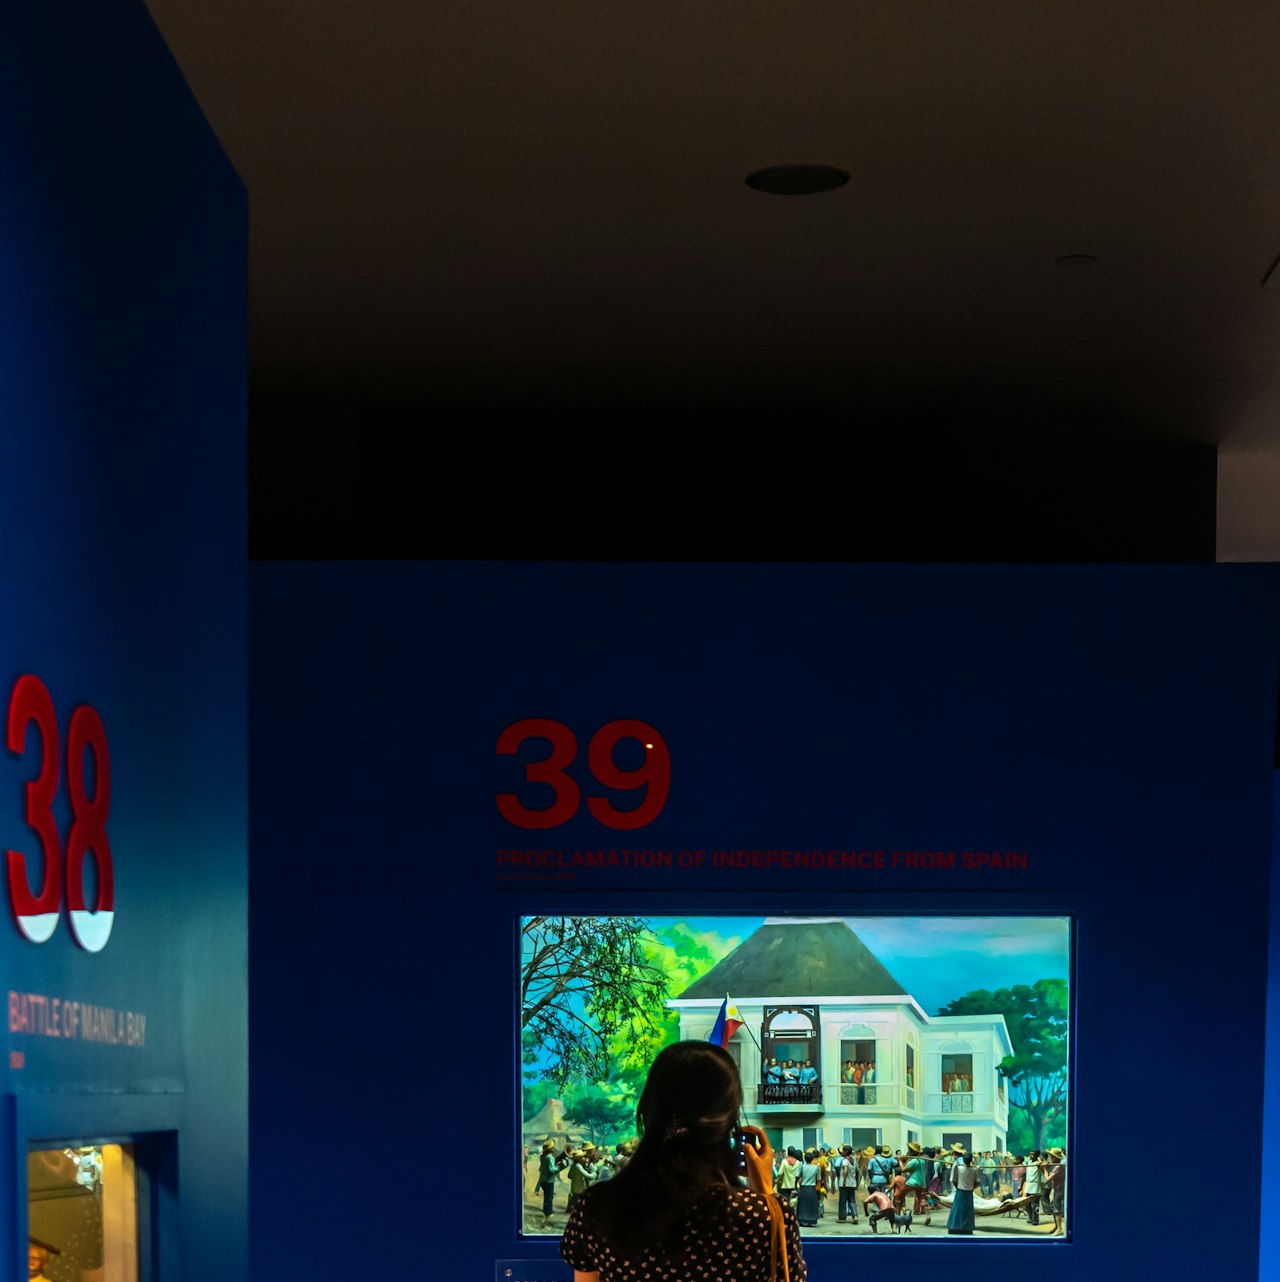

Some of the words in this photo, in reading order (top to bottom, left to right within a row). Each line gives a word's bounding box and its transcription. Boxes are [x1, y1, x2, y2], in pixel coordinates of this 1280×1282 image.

[6, 673, 114, 953] 38
[495, 718, 672, 830] 39
[496, 848, 673, 869] PROCLAMATION
[677, 849, 707, 869] OF
[713, 849, 885, 870] INDEPENDENCE
[891, 850, 956, 870] FROM
[961, 850, 1029, 871] SPAIN
[7, 990, 61, 1037] BATTLE
[63, 1000, 80, 1039] OF
[81, 1002, 124, 1046] MANILA
[127, 1012, 147, 1049] BAY
